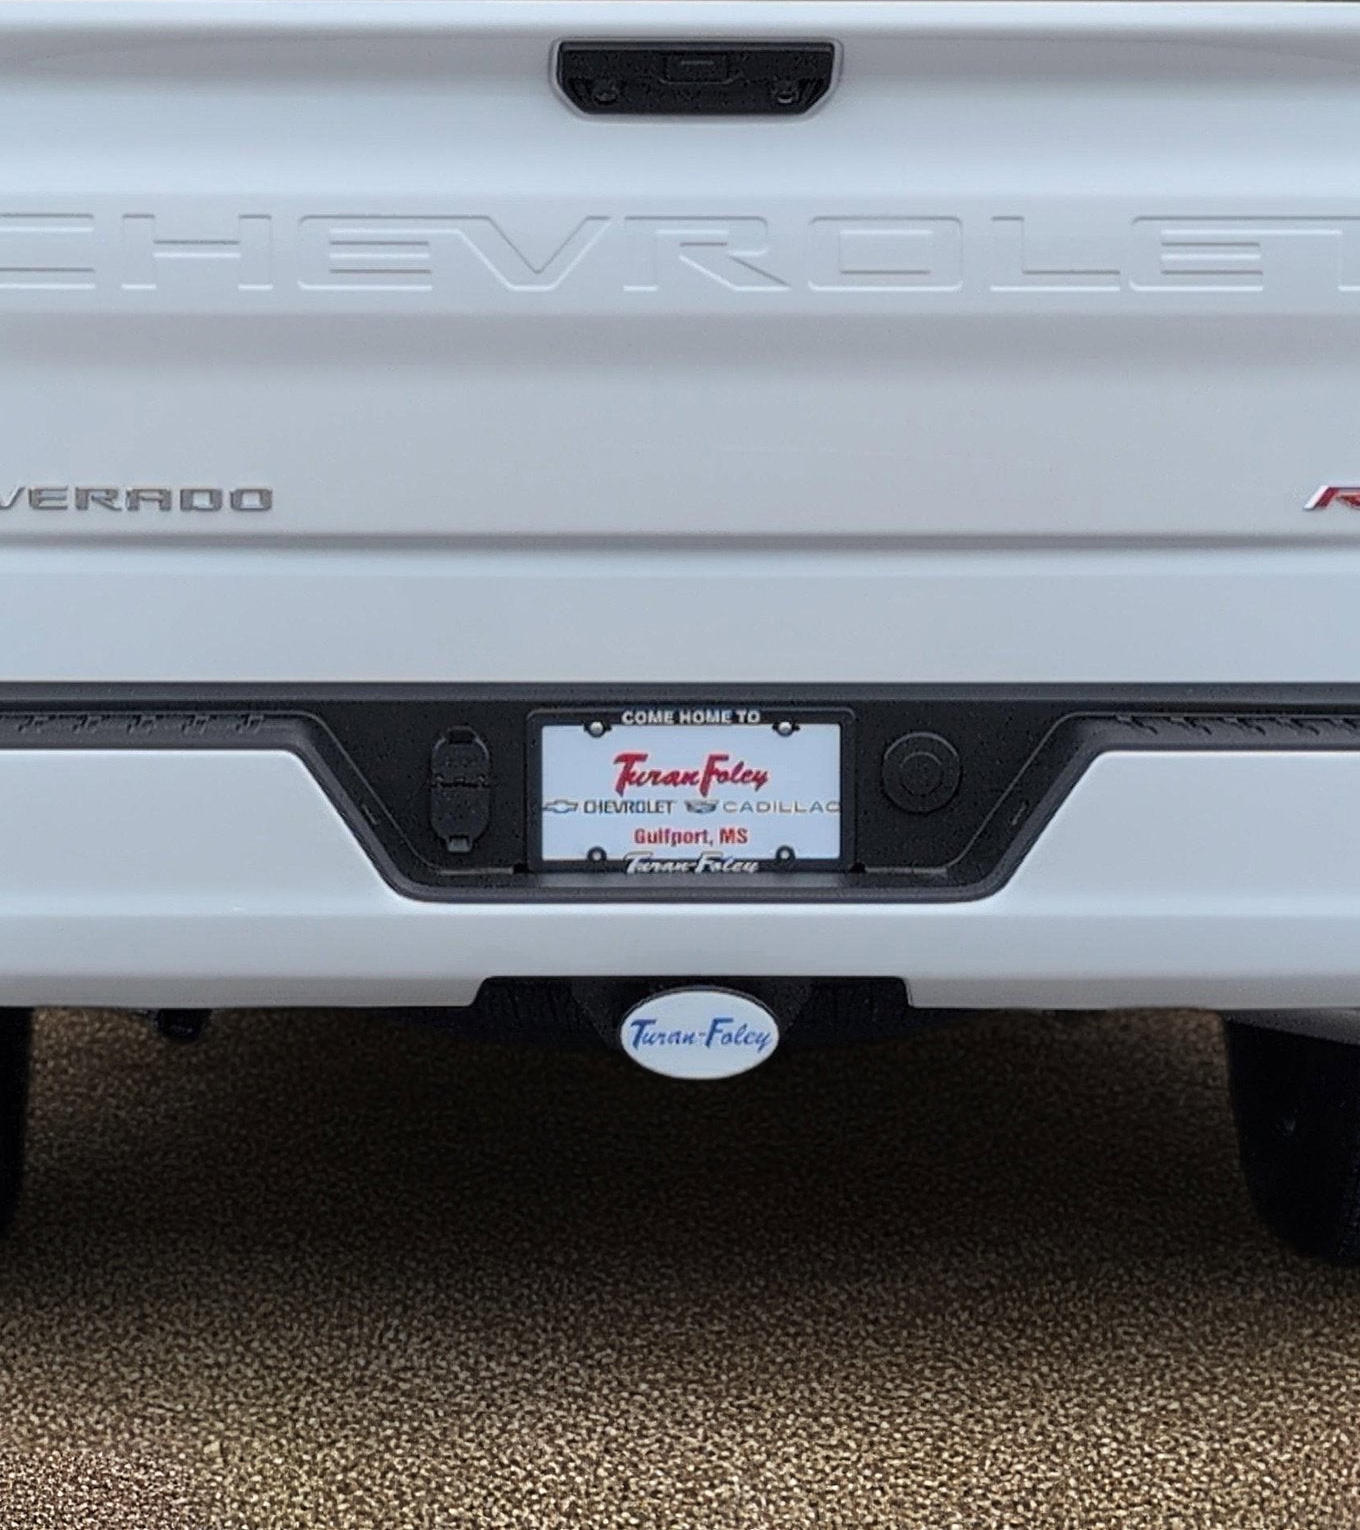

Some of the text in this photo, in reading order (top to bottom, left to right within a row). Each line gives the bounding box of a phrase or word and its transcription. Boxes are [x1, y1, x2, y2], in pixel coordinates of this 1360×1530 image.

[621, 710, 761, 725] COME HOME TO
[583, 799, 840, 814] CHEVROLET CADILLAC
[634, 828, 749, 846] Gulfport, MS
